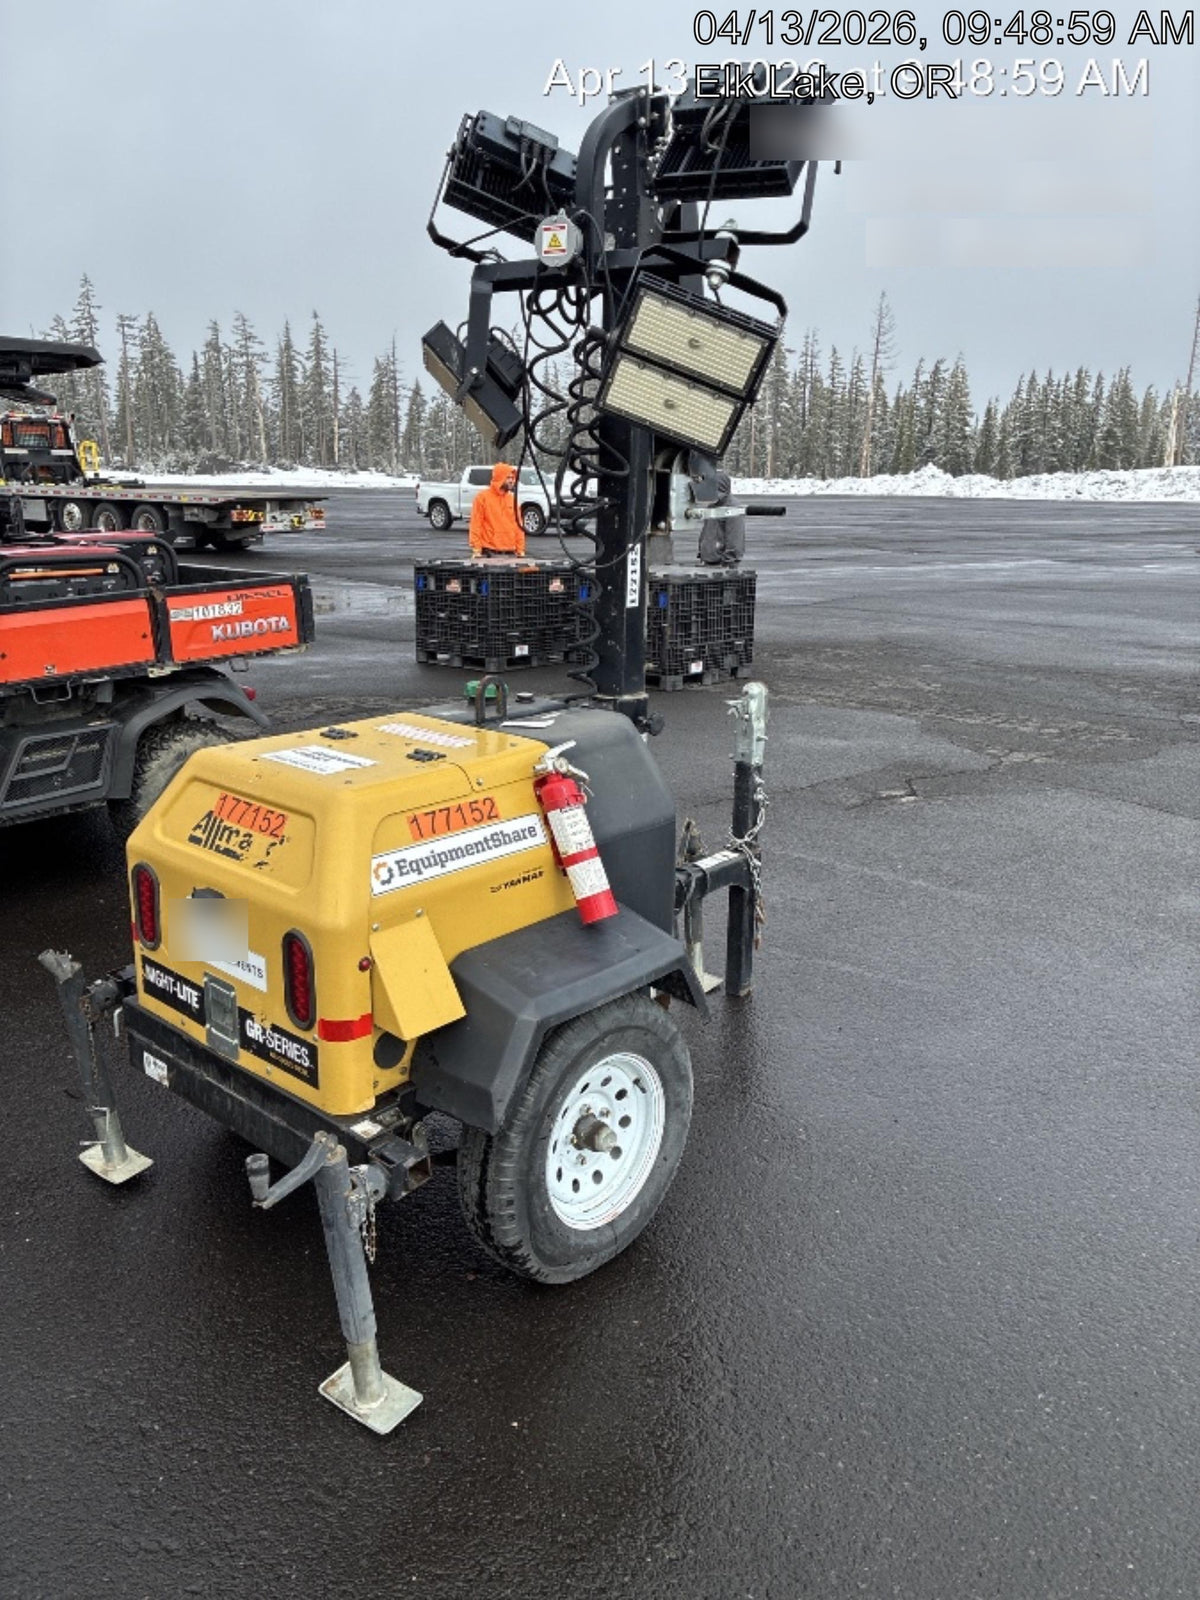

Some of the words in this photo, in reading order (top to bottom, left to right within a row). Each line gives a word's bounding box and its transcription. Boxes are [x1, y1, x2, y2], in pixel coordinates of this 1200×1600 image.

[211, 616, 292, 641] KUBOTA
[217, 793, 286, 838] 177152
[409, 797, 499, 838] 177152
[394, 823, 538, 877] EquipmentShare
[245, 1018, 310, 1068] GR-SERIES
